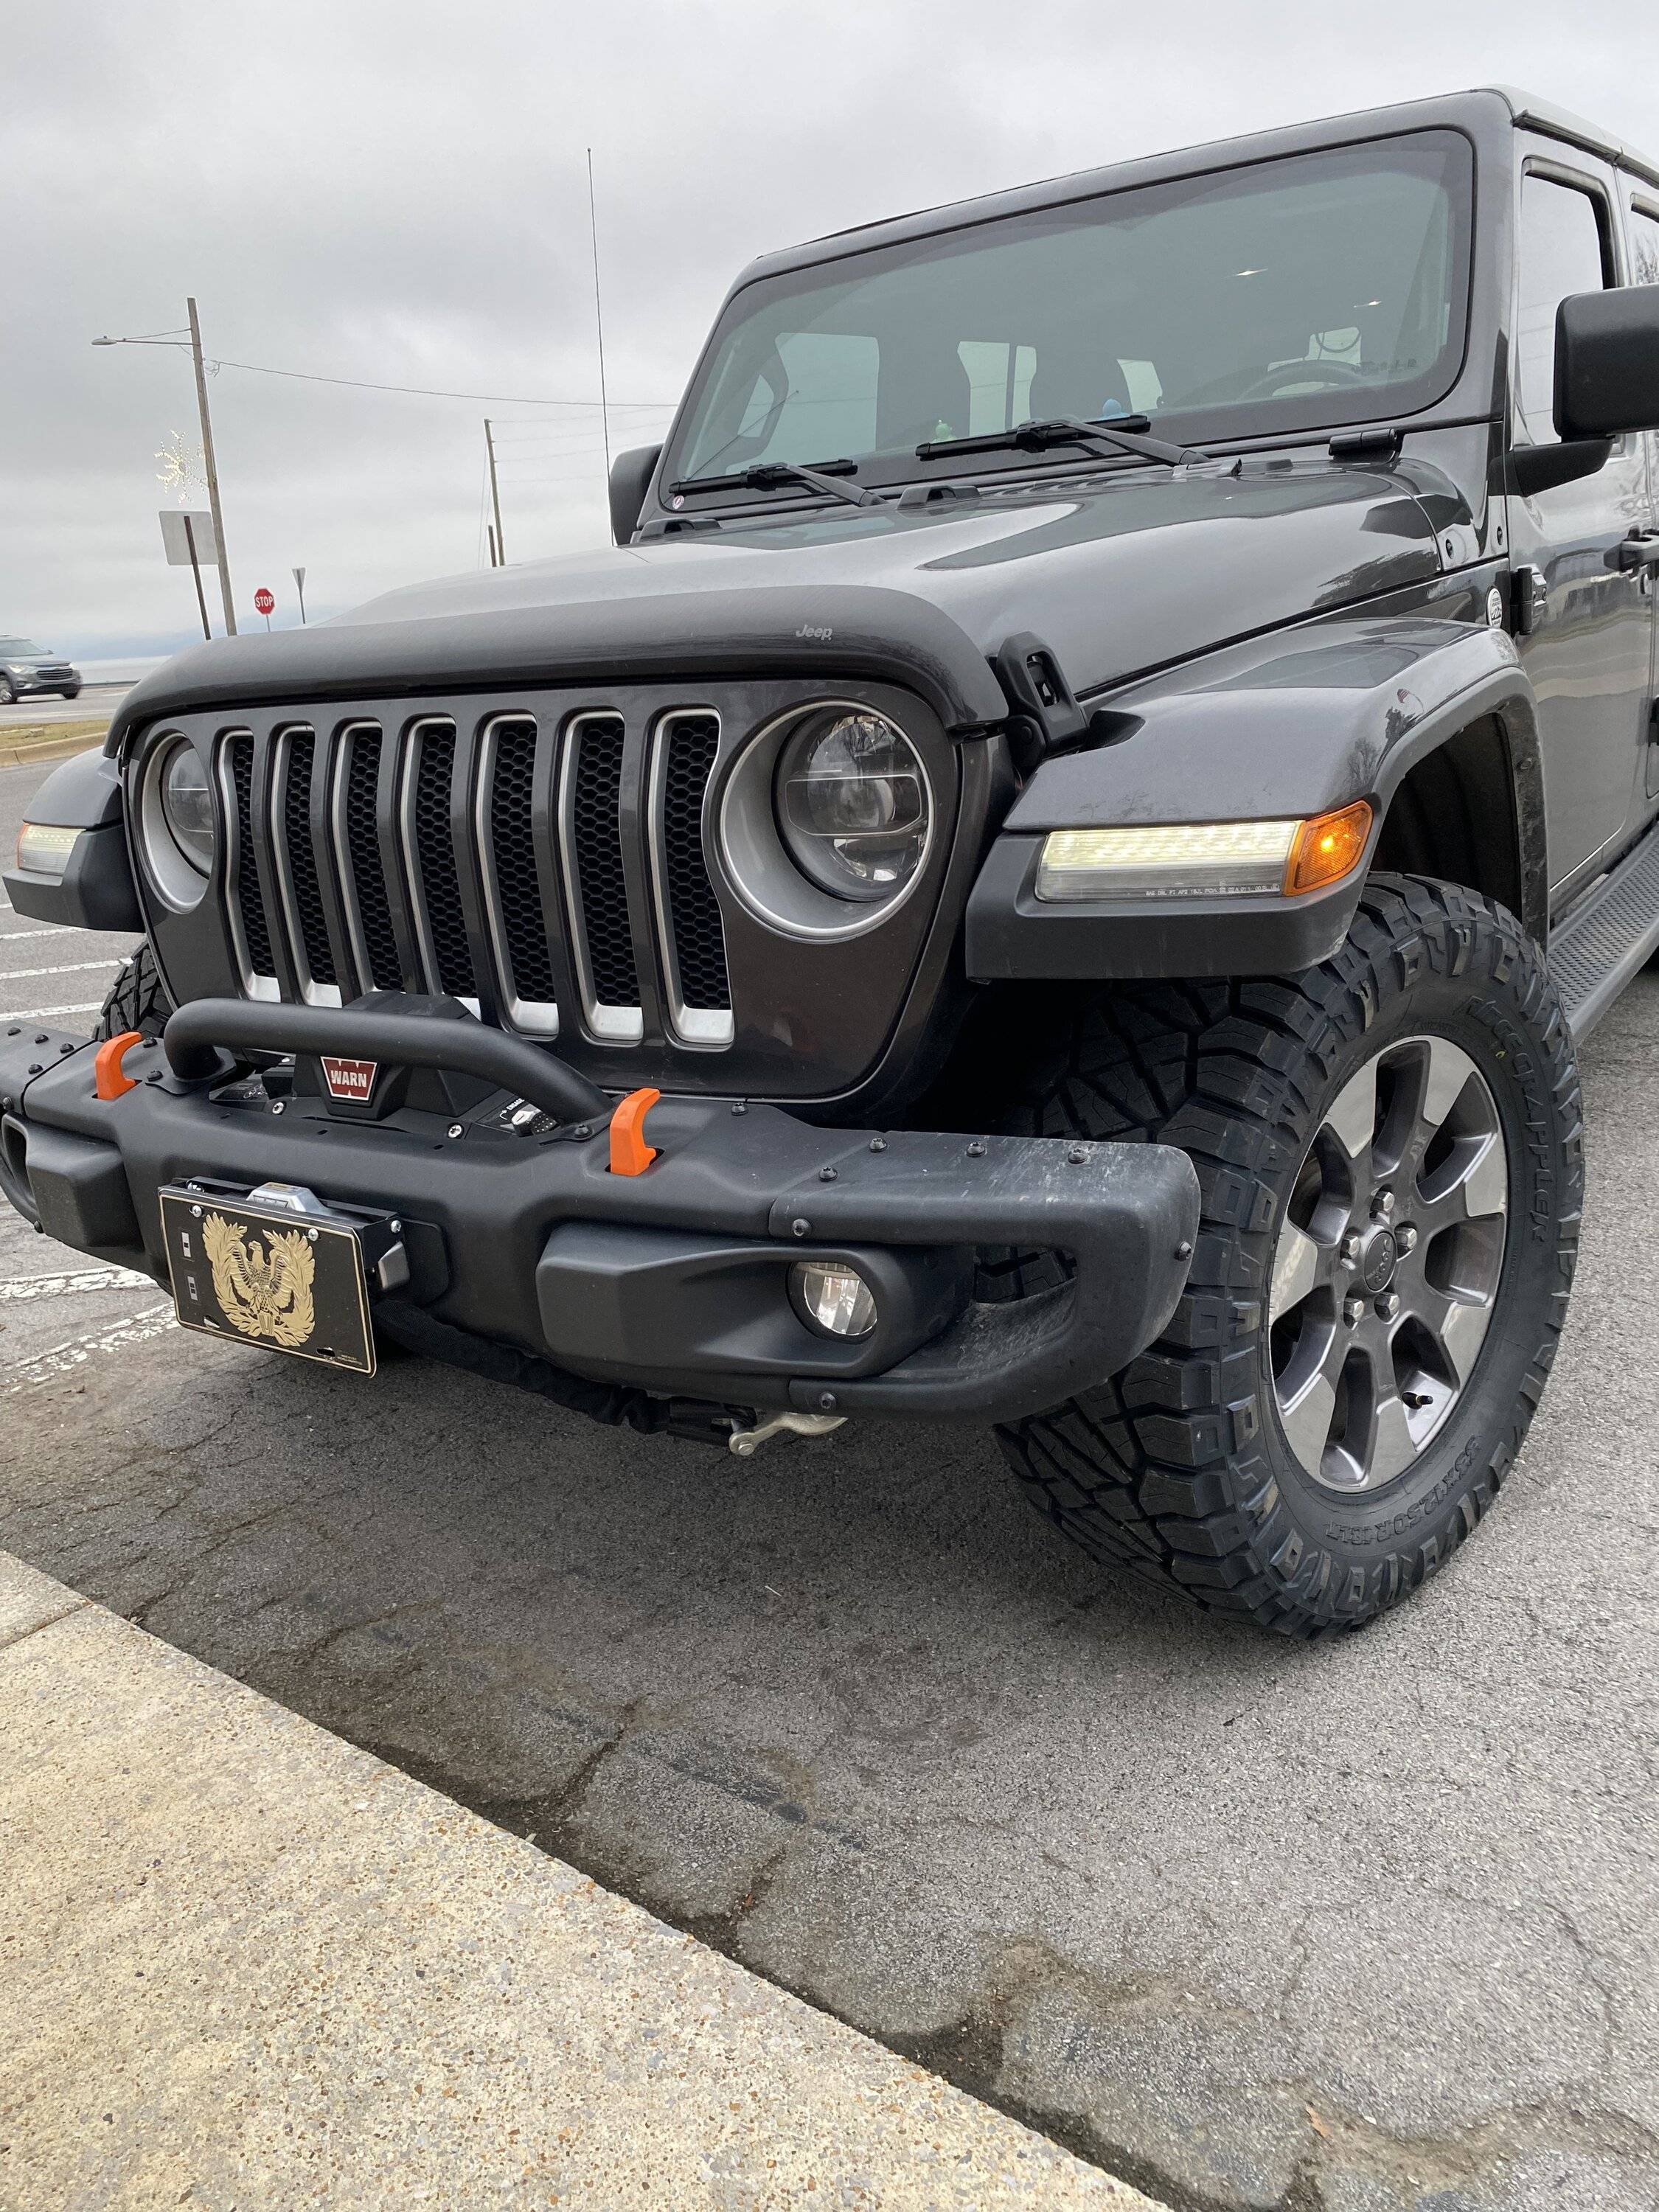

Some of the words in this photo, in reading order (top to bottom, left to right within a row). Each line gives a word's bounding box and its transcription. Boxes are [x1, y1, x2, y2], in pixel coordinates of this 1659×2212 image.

[255, 596, 273, 607] STOP
[796, 624, 832, 641] Jeep
[330, 1070, 367, 1088] WARN
